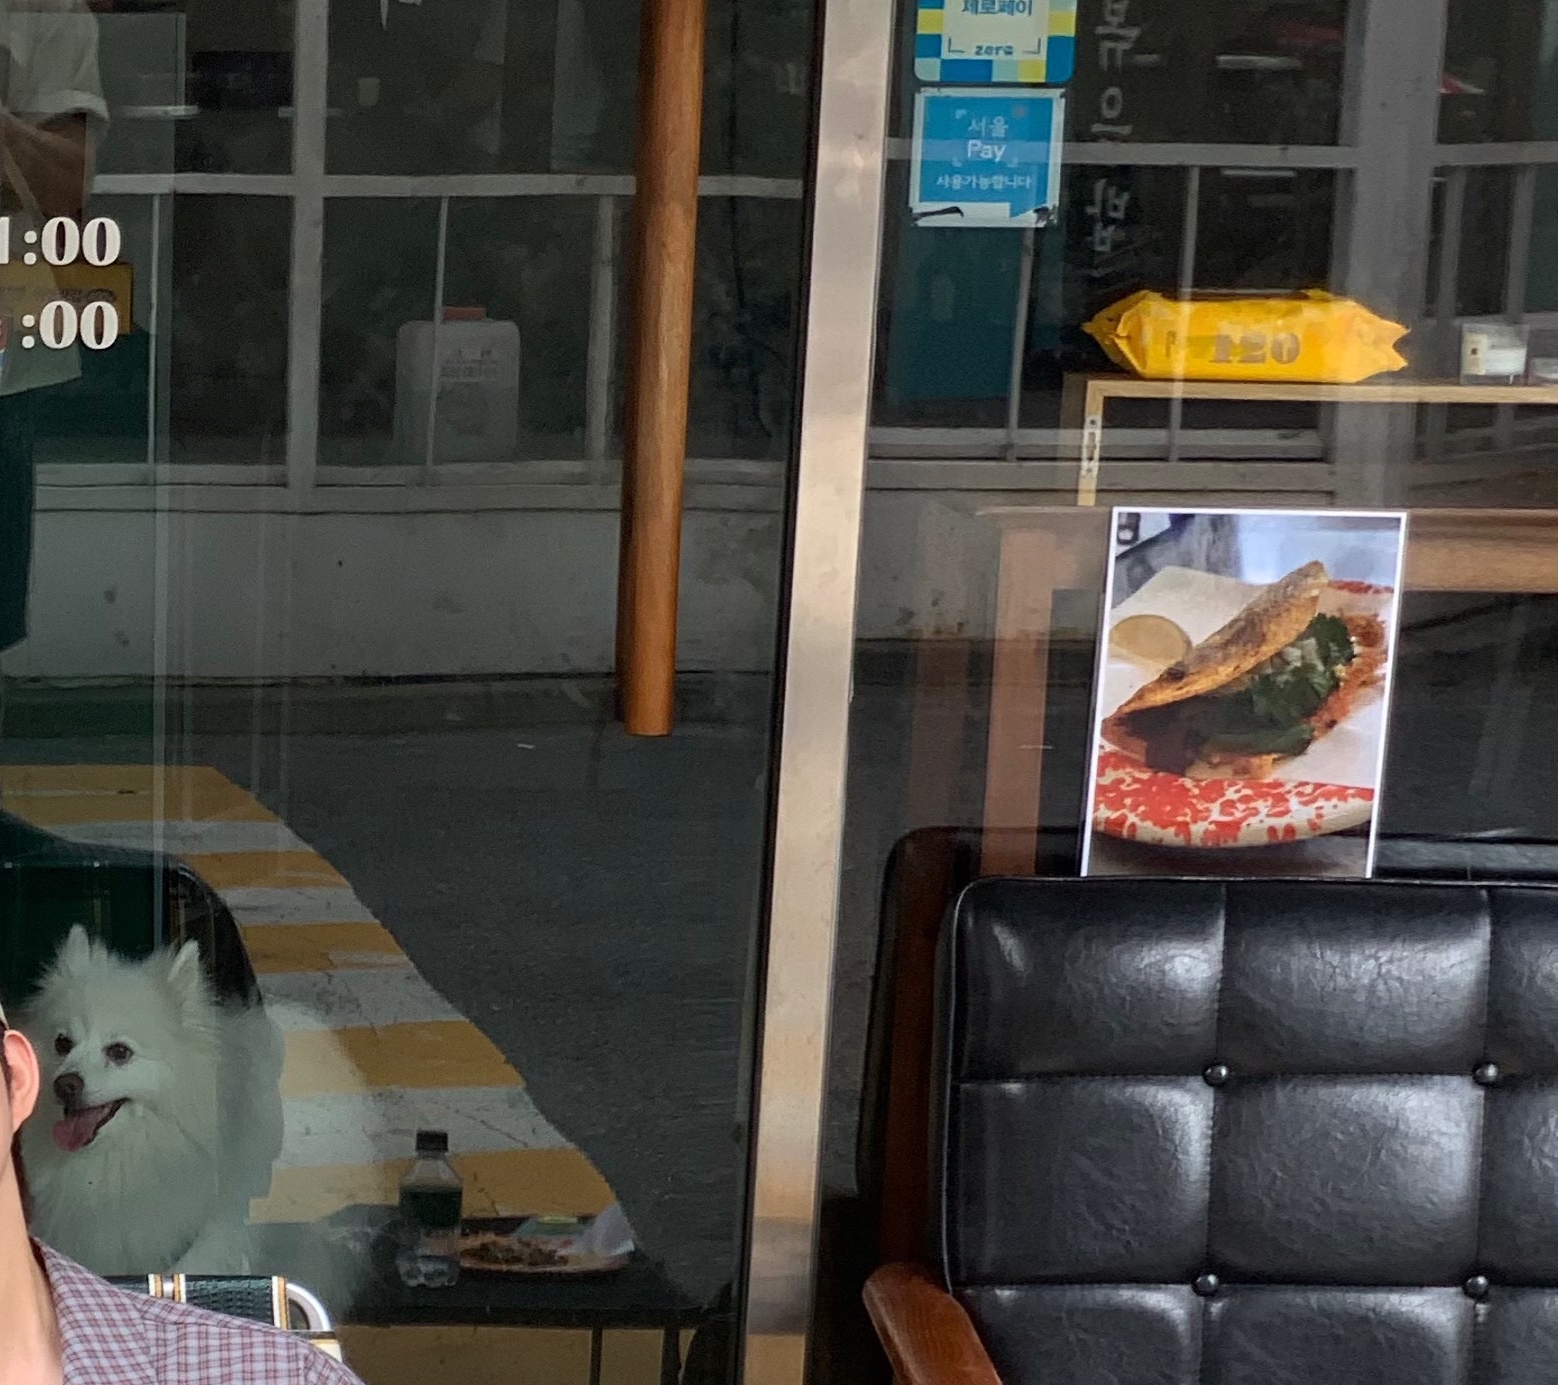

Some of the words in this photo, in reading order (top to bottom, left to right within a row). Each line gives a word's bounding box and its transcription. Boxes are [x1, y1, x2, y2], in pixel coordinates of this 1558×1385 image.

[968, 115, 1009, 138] 서울
[967, 139, 1007, 163] Pay
[935, 174, 1035, 190] 사용가능합니다
